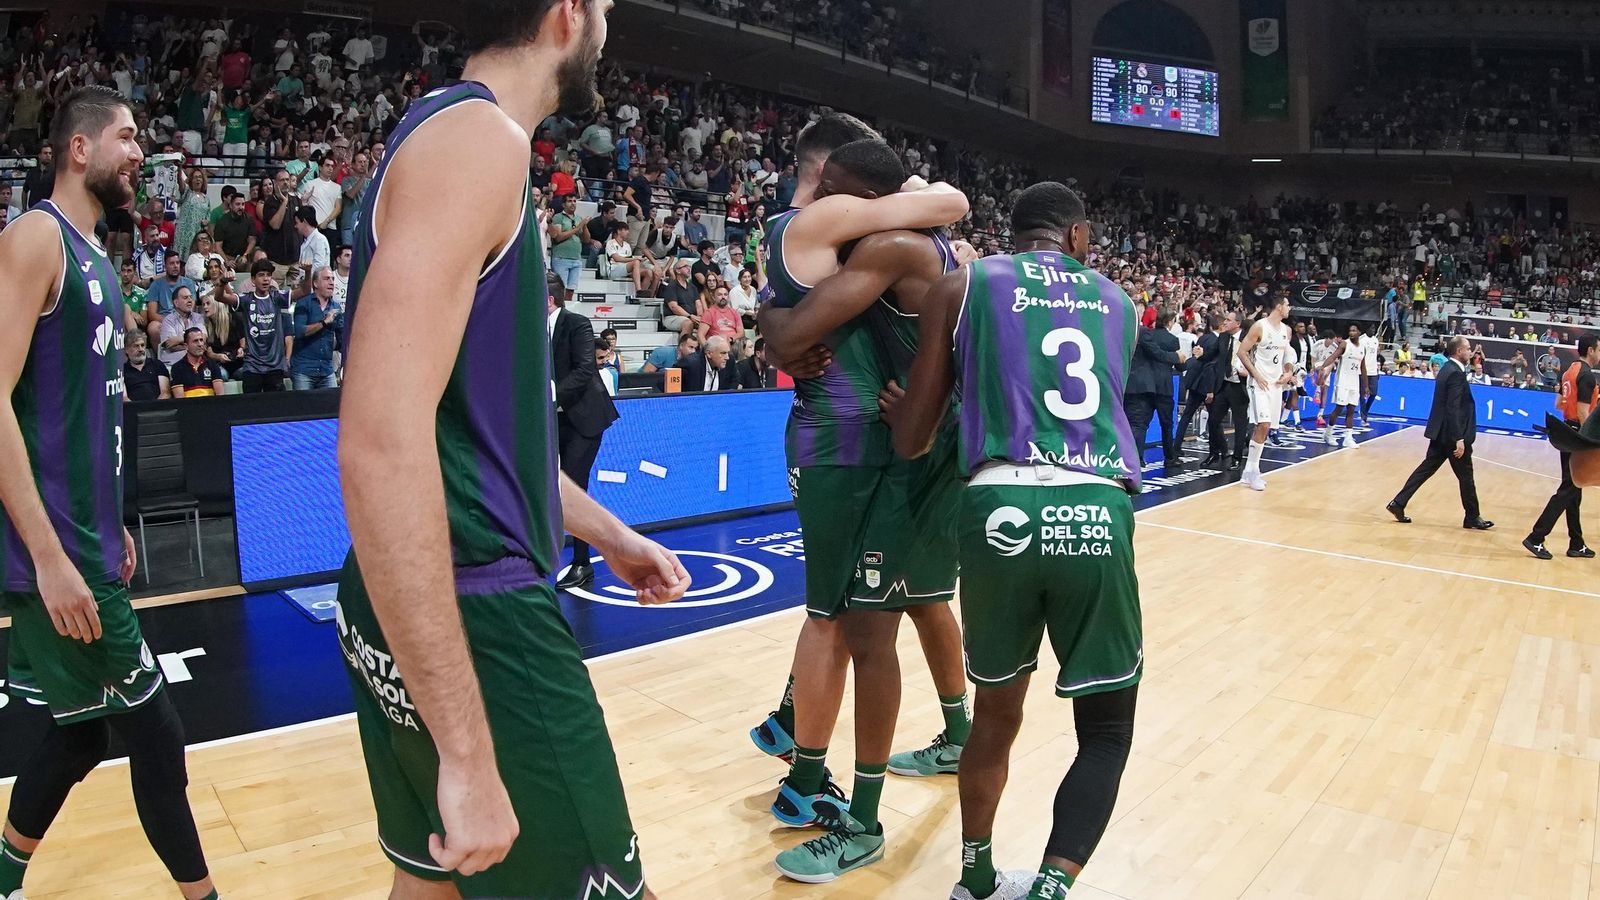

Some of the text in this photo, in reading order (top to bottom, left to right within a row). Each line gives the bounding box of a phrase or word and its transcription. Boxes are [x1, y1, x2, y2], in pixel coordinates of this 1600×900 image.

[1136, 83, 1148, 94] 80
[1165, 87, 1178, 98] 90
[1149, 97, 1164, 106] 0.0
[1021, 261, 1089, 287] Ejim
[1272, 353, 1279, 365] 6
[1041, 327, 1100, 420] 3
[1025, 441, 1133, 473] Andalucía
[1041, 505, 1112, 523] COSTA
[1041, 525, 1113, 540] DEL SOL
[1041, 540, 1112, 556] MÁLAGA
[373, 675, 415, 711] SOL
